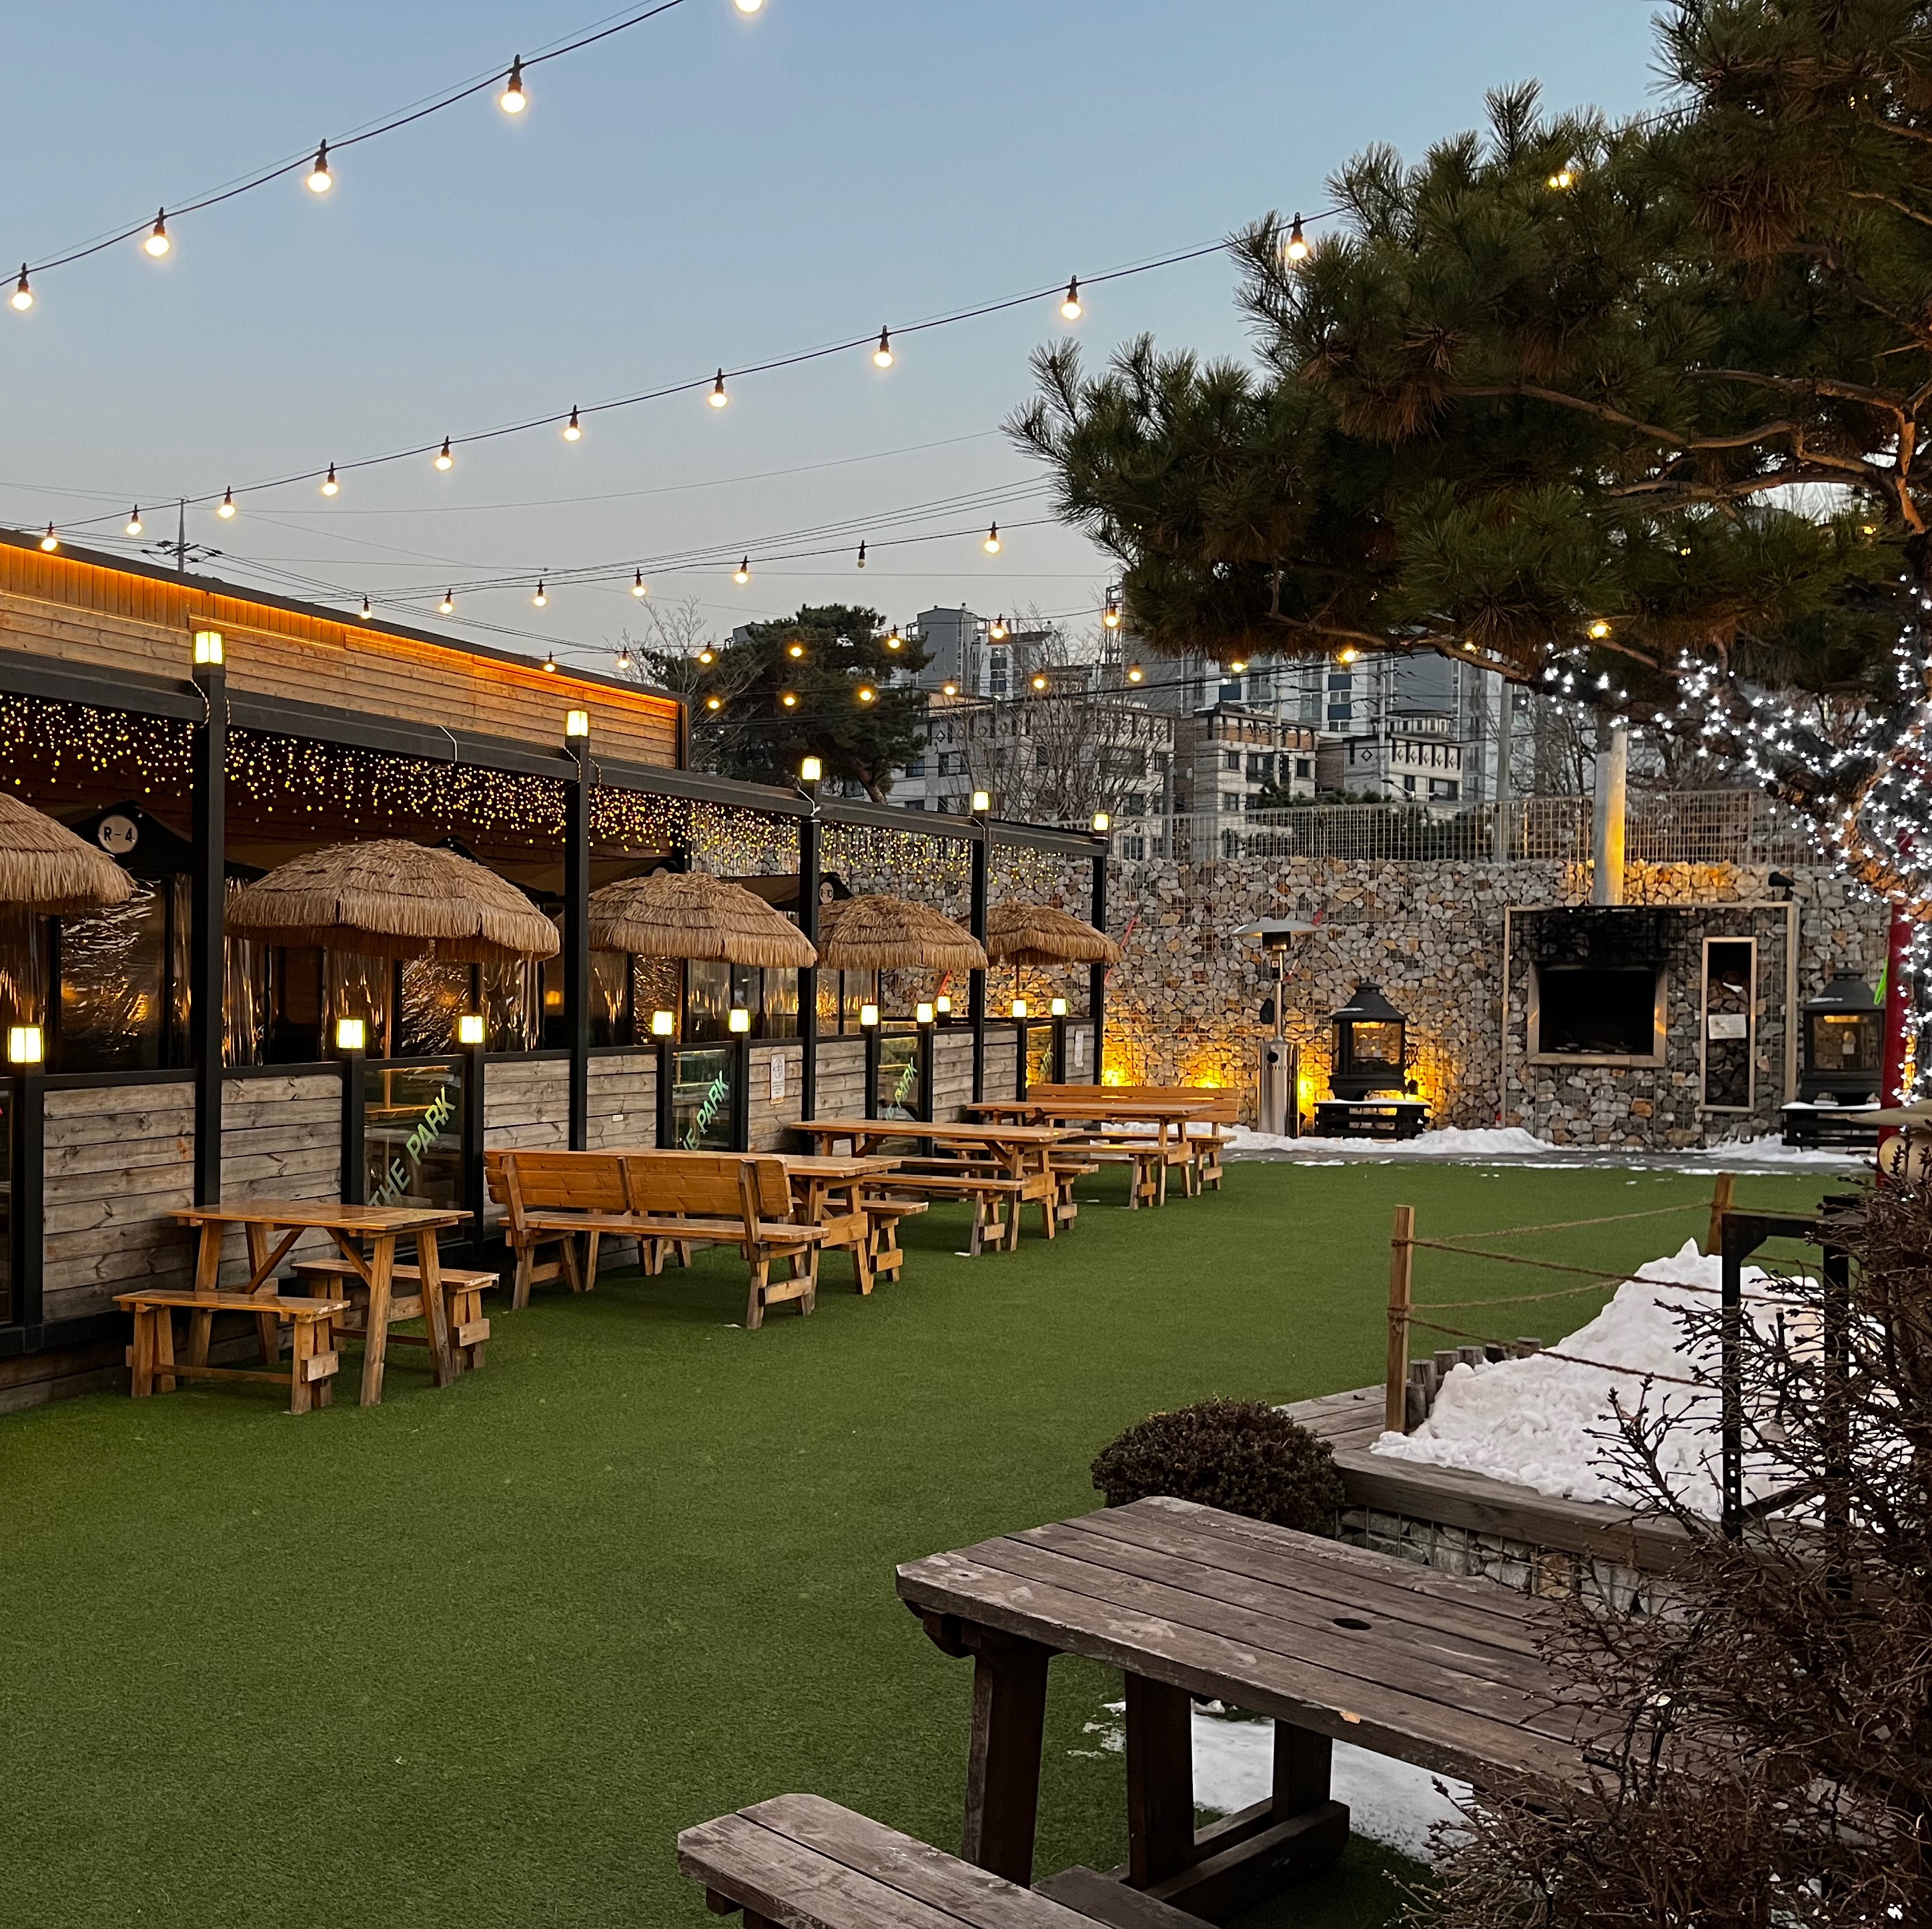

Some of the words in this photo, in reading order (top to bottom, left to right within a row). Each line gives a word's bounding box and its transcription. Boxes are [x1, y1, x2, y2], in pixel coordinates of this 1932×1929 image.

[103, 826, 133, 842] R-4
[696, 1070, 729, 1135] PARK
[894, 1056, 918, 1110] PARK
[368, 1158, 411, 1206] THE
[406, 1086, 456, 1166] PARK
